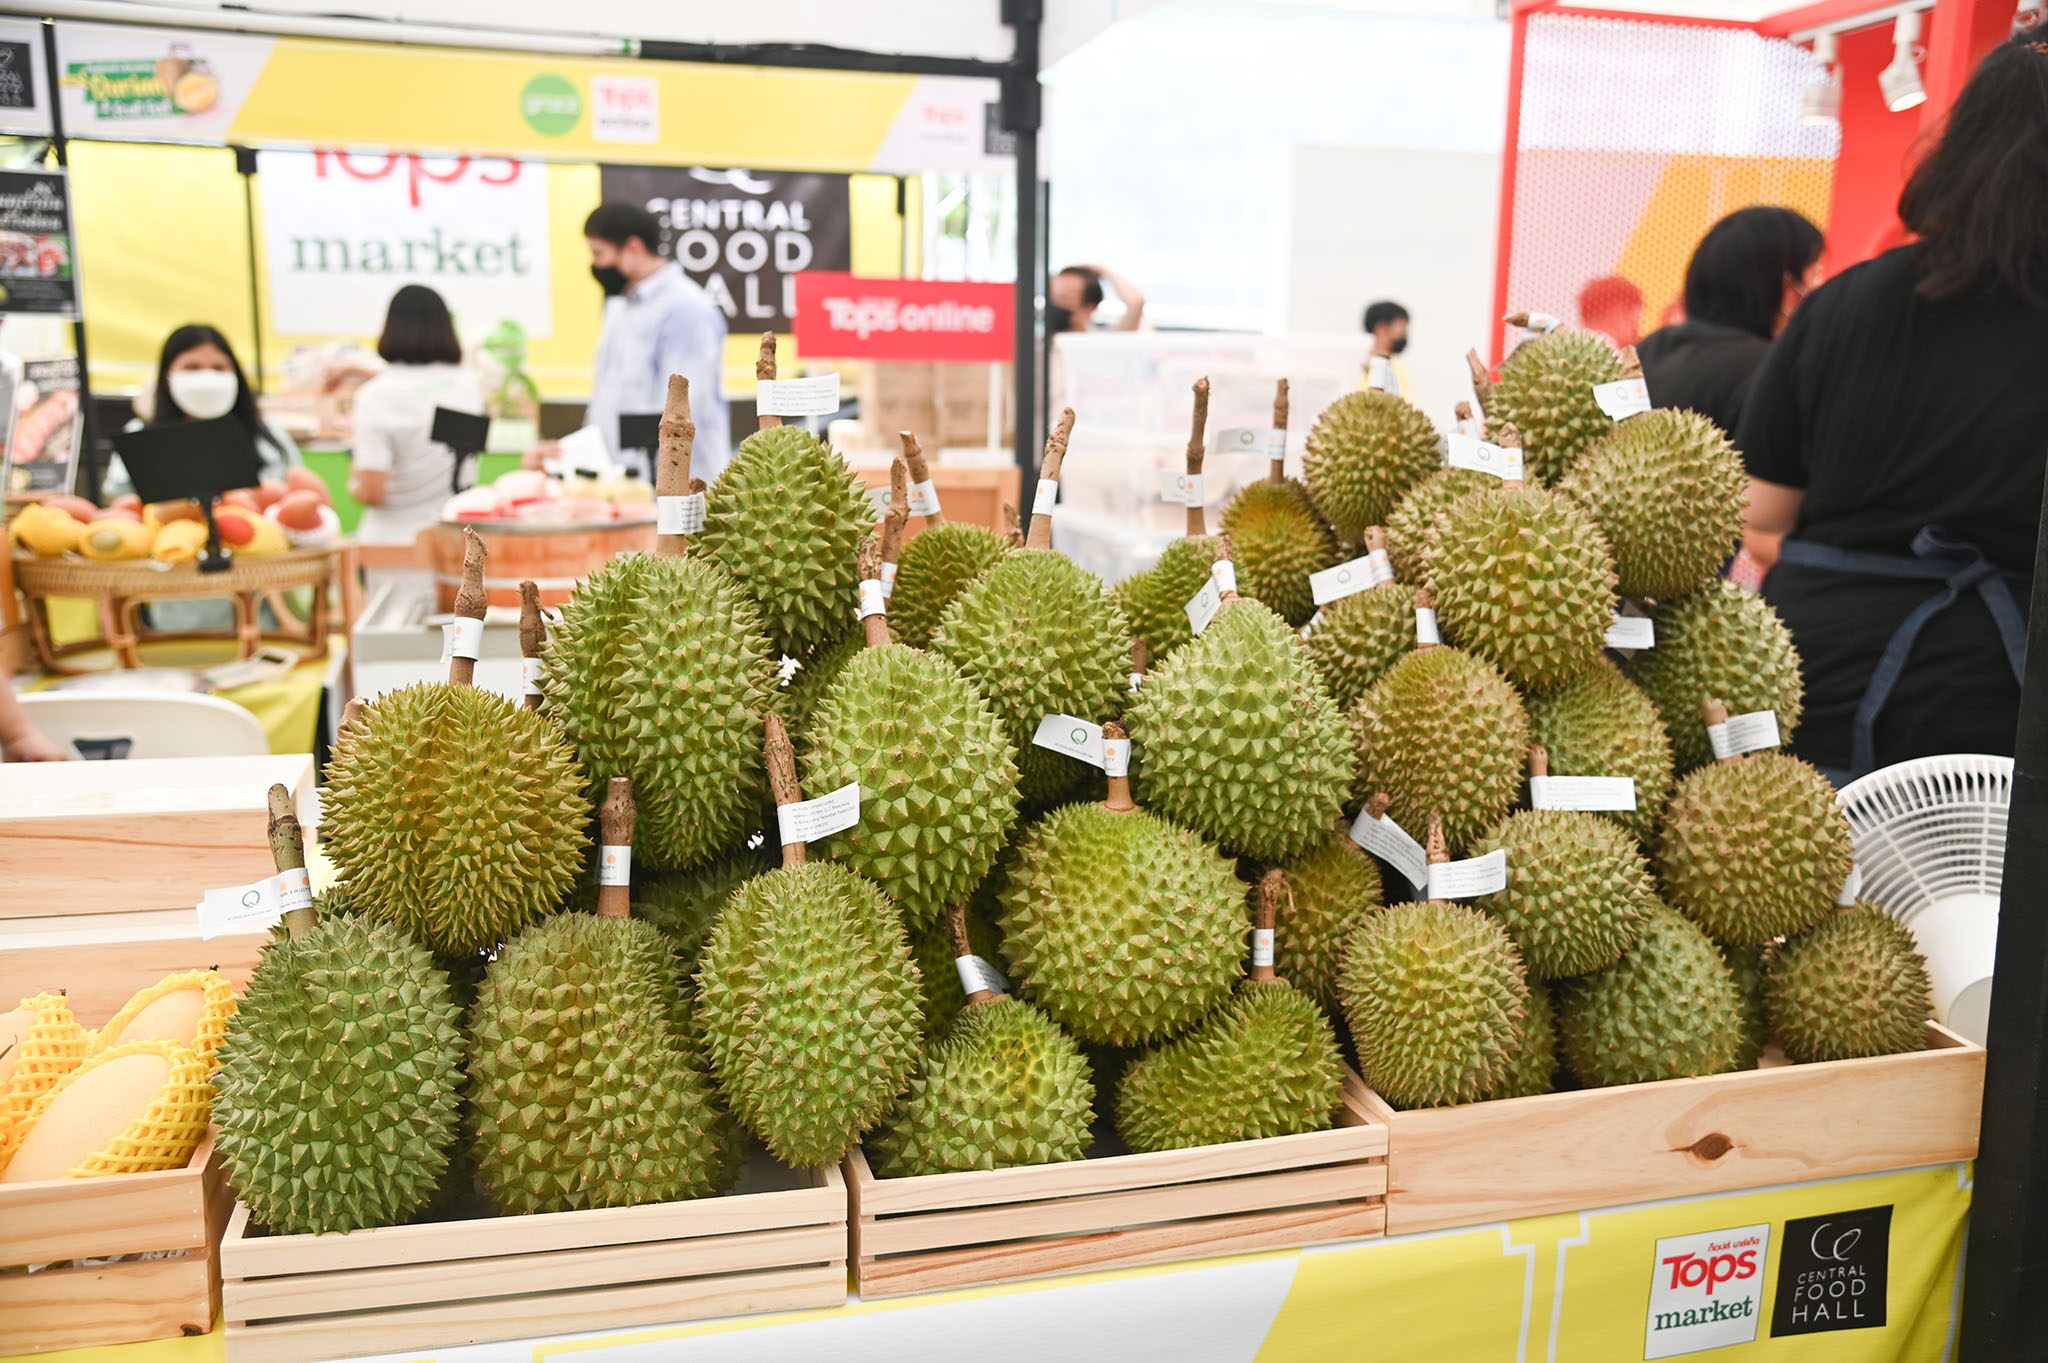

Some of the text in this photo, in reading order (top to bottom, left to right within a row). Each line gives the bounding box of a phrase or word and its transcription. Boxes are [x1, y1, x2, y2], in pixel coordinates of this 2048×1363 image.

[289, 228, 530, 275] market
[660, 229, 813, 273] OOD
[822, 297, 995, 339] Tops online
[1662, 1249, 1758, 1295] Tops
[1794, 1279, 1866, 1303] FOOD
[1797, 1265, 1866, 1284] CENTRAL
[1654, 1295, 1753, 1331] market
[1792, 1299, 1865, 1324] HALL
